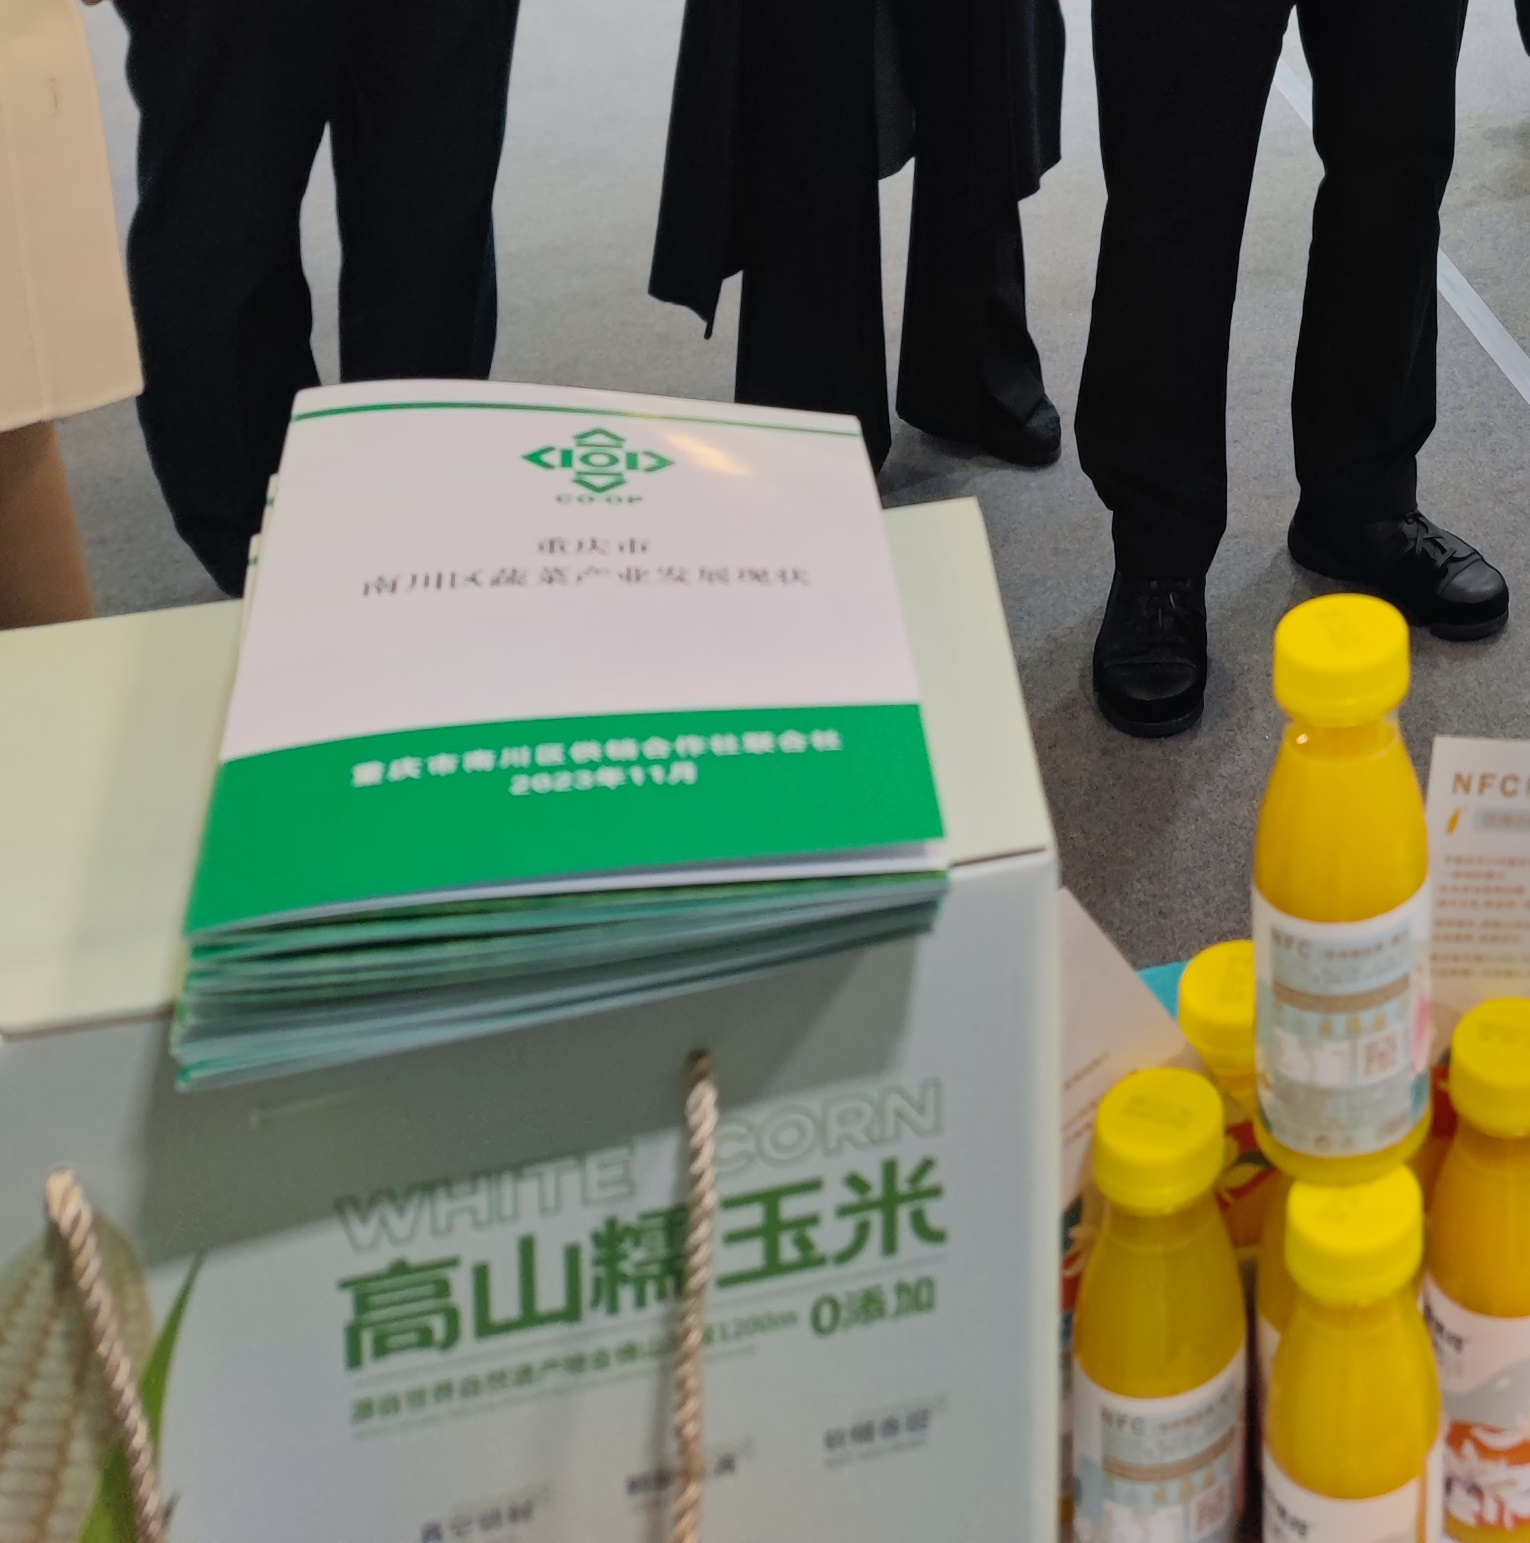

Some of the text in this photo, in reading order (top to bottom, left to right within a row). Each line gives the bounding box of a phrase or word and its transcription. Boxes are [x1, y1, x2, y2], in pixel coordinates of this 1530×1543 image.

[509, 759, 698, 797] 2023年11月
[333, 1140, 638, 1255] WHITE
[715, 1076, 945, 1179] CORN
[336, 1156, 947, 1371] 高山糯玉米
[810, 1276, 938, 1339] 0添加
